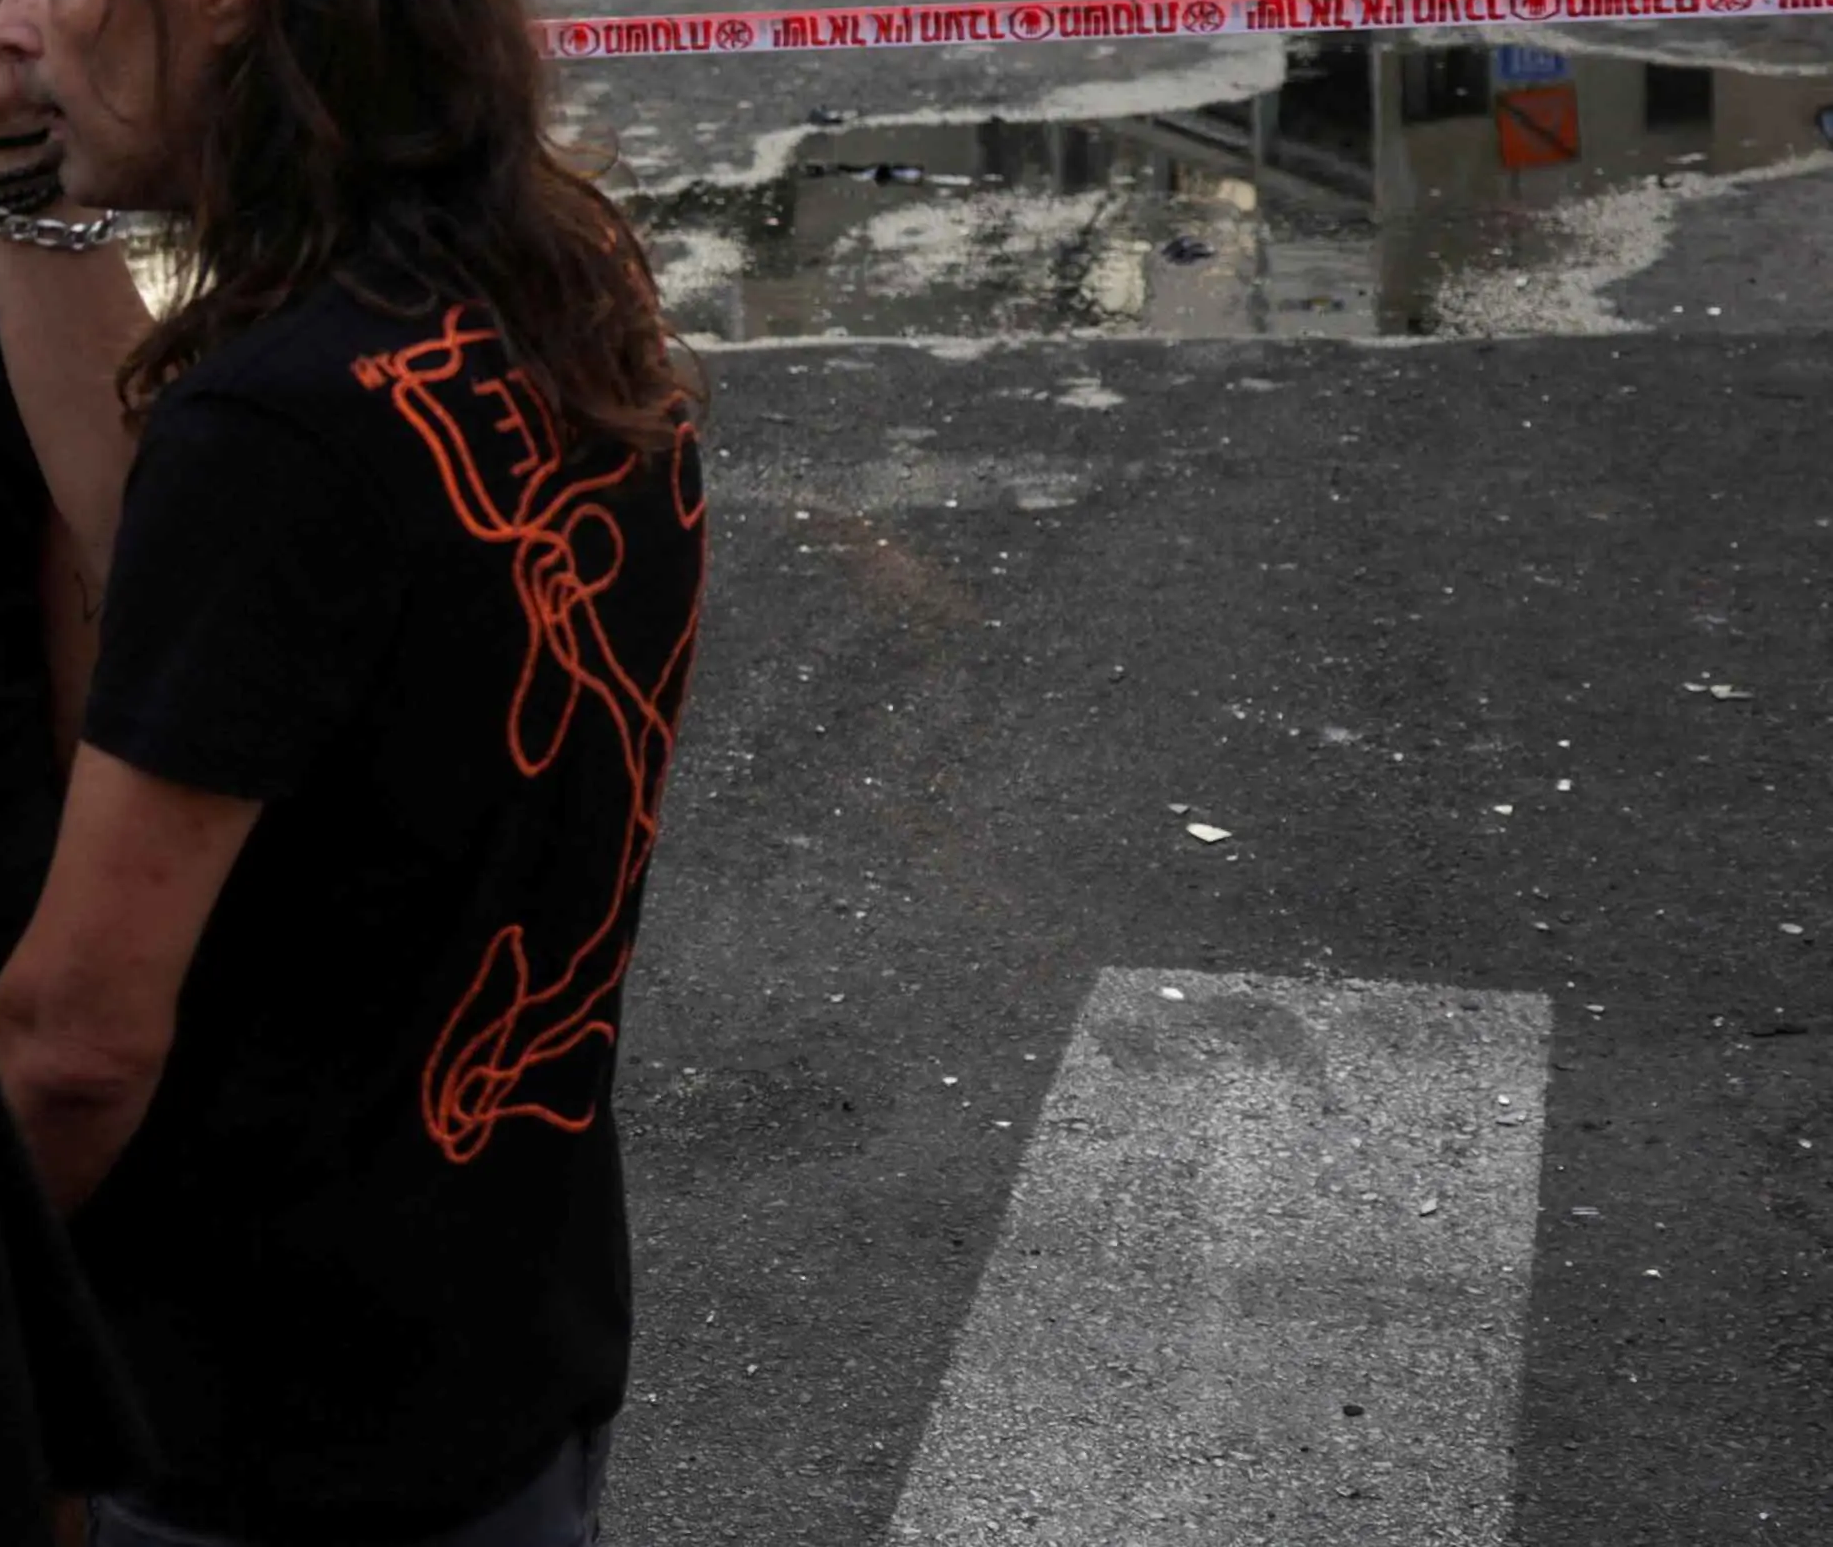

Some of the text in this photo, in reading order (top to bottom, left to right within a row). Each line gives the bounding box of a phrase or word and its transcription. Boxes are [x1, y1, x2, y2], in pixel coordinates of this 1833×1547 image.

[603, 18, 712, 54] משטרת
[772, 14, 867, 49] ישראל
[874, 8, 912, 43] אין
[920, 8, 1005, 42] מעבר
[1059, 0, 1179, 37] משטרת
